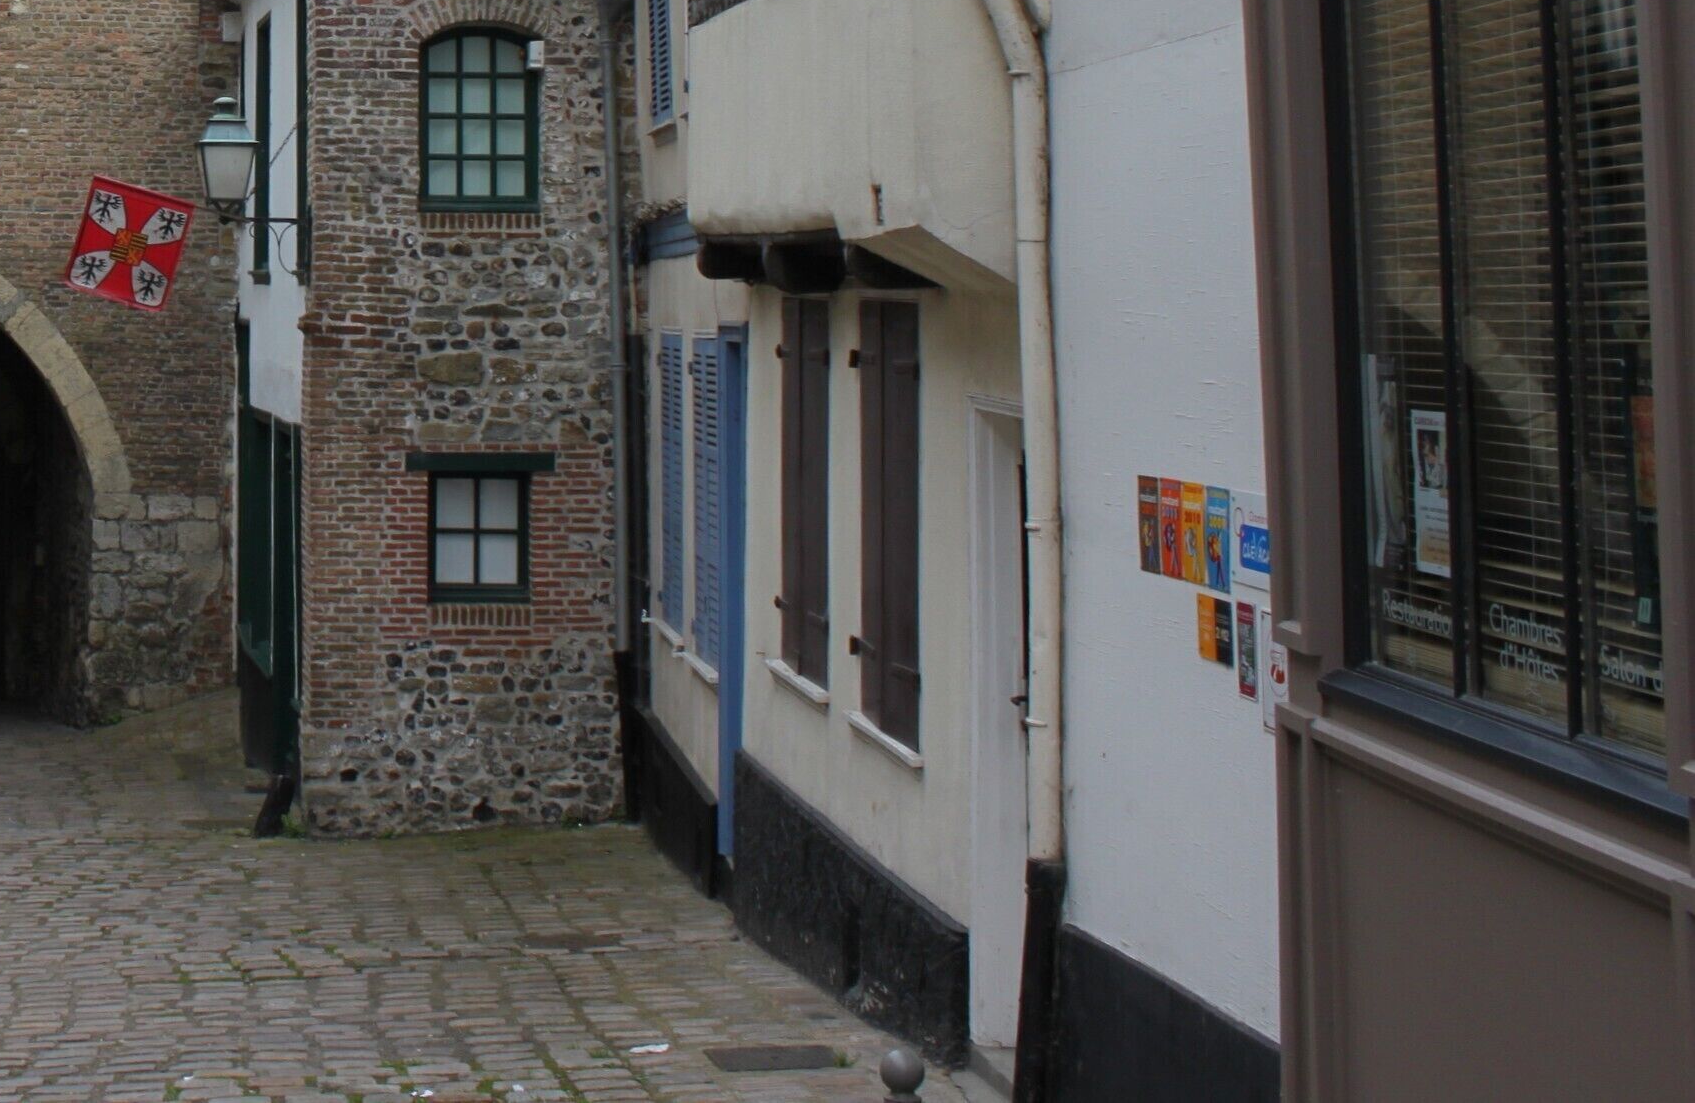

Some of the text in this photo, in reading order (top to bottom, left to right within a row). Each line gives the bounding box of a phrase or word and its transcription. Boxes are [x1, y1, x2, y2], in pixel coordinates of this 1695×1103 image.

[1382, 588, 1453, 635] Restauratio
[1488, 603, 1562, 647] Chambres
[1500, 642, 1559, 682] d'Hôtes
[1598, 645, 1663, 692] Salon d
